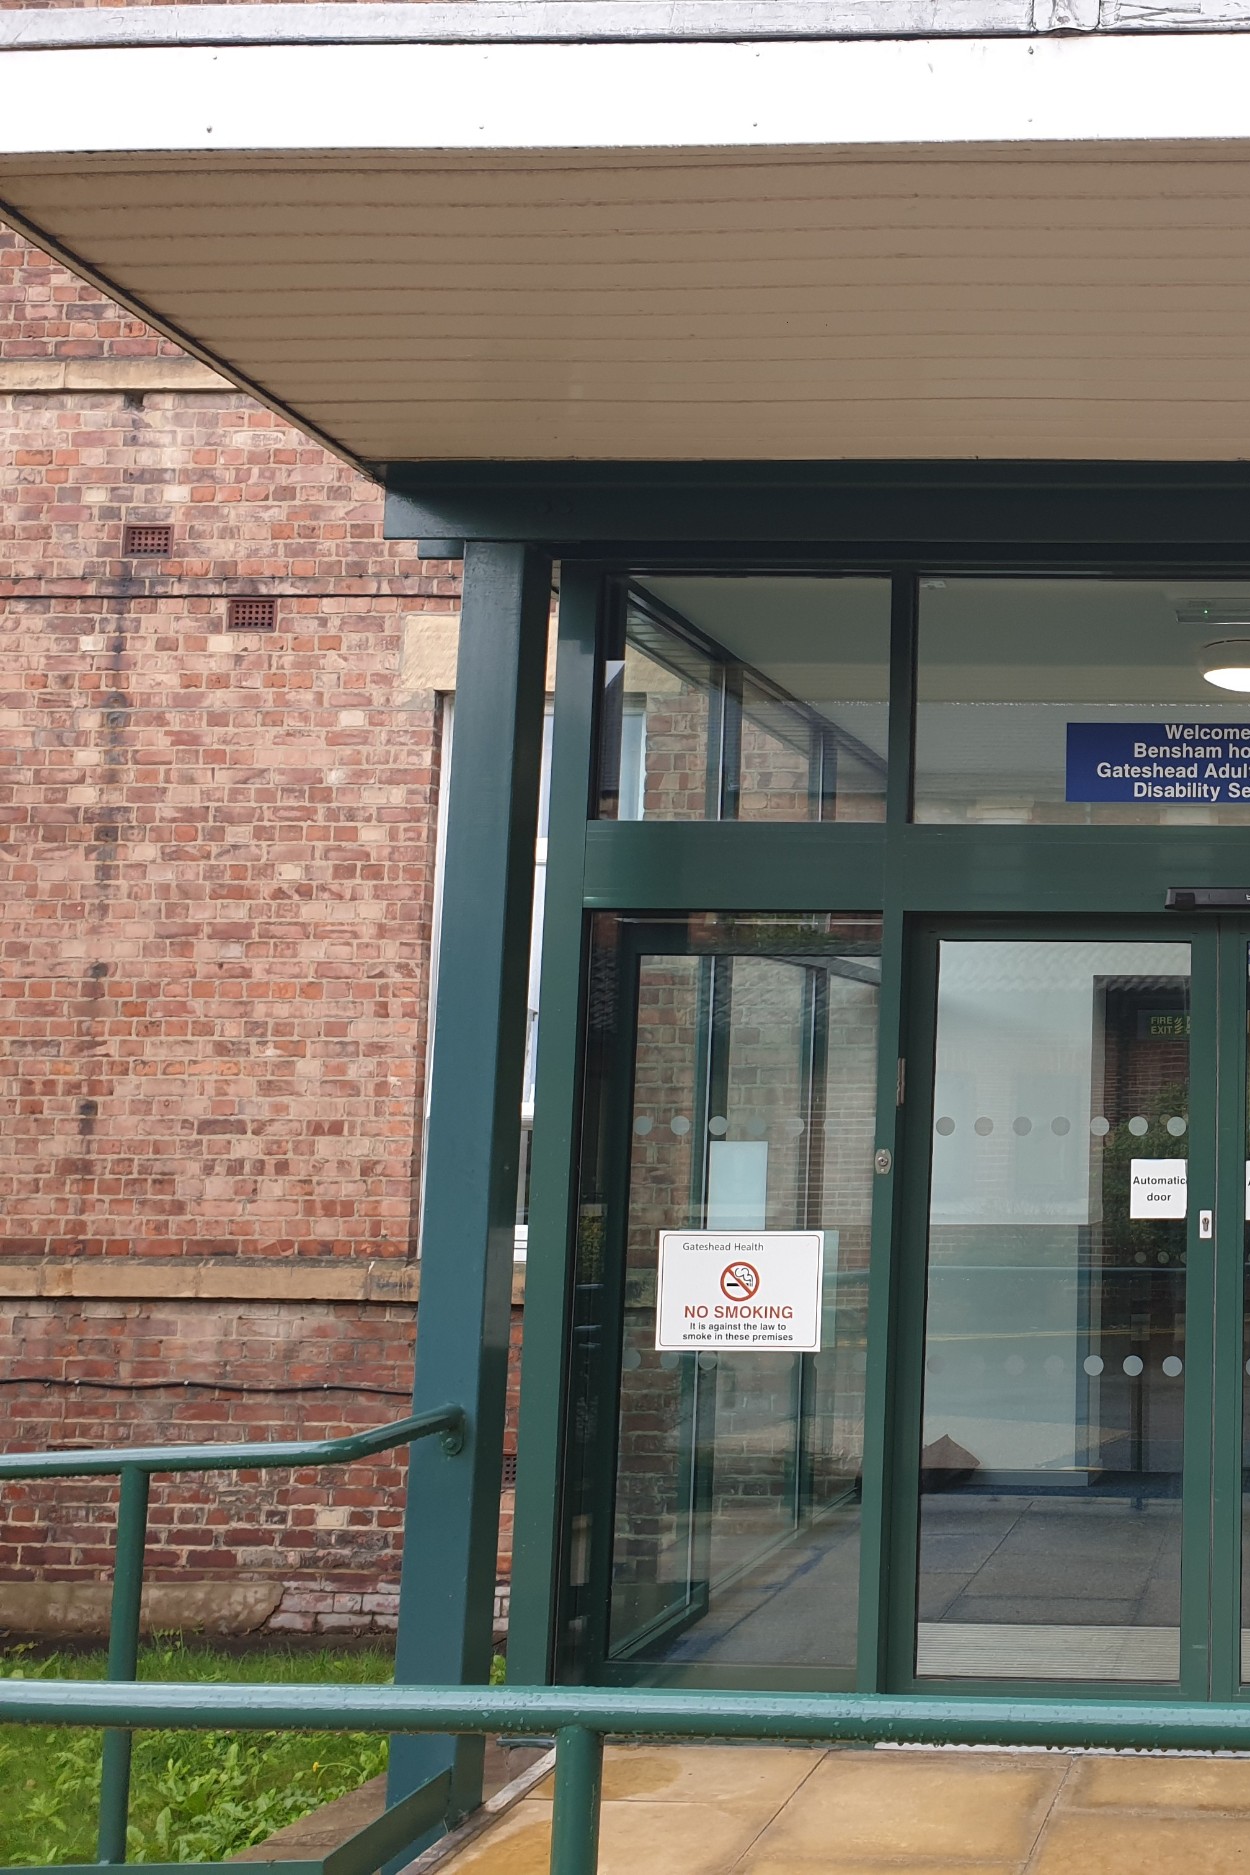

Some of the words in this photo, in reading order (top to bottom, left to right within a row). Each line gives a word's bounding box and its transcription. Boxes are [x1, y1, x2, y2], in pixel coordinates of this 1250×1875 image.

[1165, 724, 1250, 740] Welcome
[1134, 742, 1222, 759] Bensham
[1097, 762, 1198, 778] Gateshead
[1134, 782, 1220, 802] Disability
[1150, 1016, 1173, 1025] FIRE
[1150, 1025, 1173, 1035] EXIT
[1133, 1175, 1186, 1185] Automatic
[1146, 1192, 1172, 1201] door
[682, 1242, 731, 1251] Gateshead
[734, 1242, 764, 1251] Health
[684, 1305, 709, 1319] NO
[714, 1305, 793, 1319] SMOKING
[690, 1322, 696, 1330] It
[698, 1322, 706, 1330] is
[708, 1322, 741, 1332] against
[743, 1323, 758, 1331] the
[760, 1323, 775, 1331] law
[777, 1323, 787, 1331] to
[682, 1333, 712, 1341] smoke
[714, 1332, 723, 1340] in
[725, 1333, 750, 1341] these
[752, 1333, 793, 1343] premises
